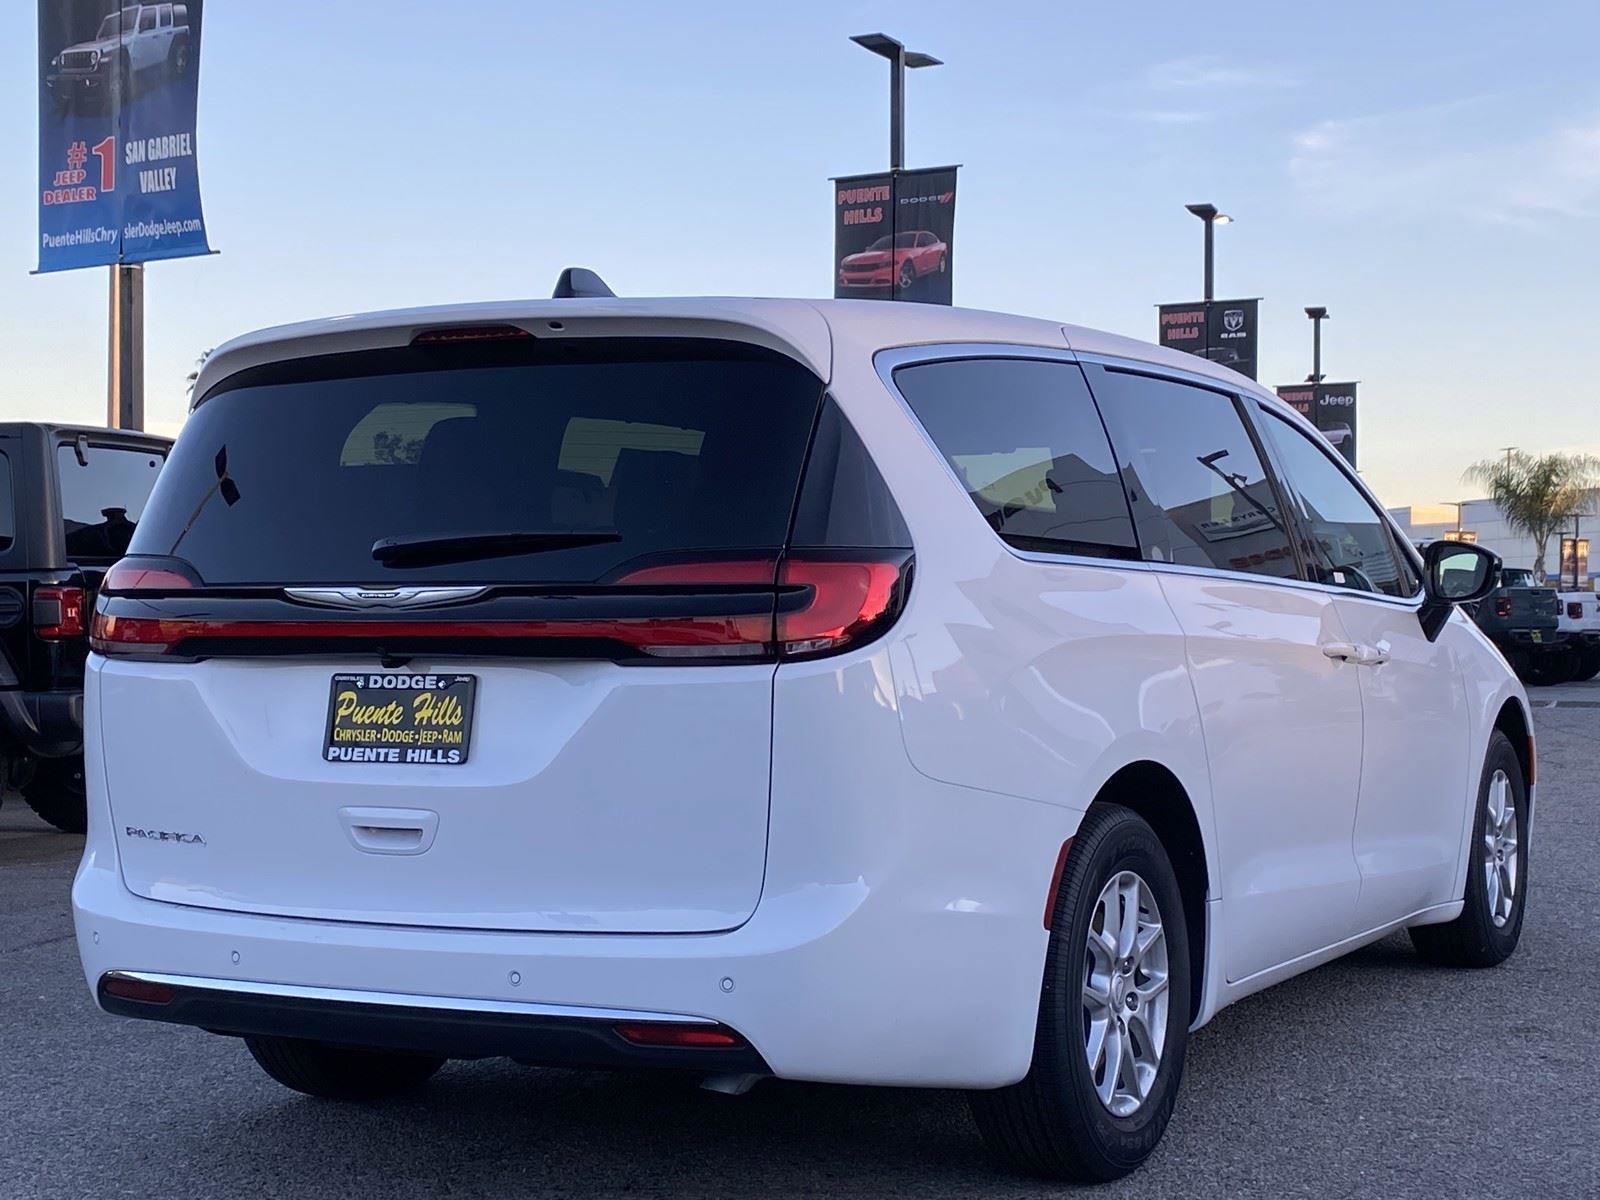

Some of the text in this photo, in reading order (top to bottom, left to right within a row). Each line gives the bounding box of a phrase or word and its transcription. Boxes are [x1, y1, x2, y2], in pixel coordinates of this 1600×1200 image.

[125, 133, 192, 165] SAN GABRIEL
[52, 169, 87, 186] JEEP
[139, 167, 177, 194] VALLEY
[43, 187, 97, 205] DEALER
[838, 186, 890, 205] PUENTE
[843, 207, 883, 225] HILLS
[1161, 311, 1204, 325] PUENTE
[1167, 326, 1198, 340] HILLS
[1319, 394, 1354, 406] Jeep
[369, 676, 437, 689] DODGE
[335, 691, 463, 726] Puente Hills
[328, 746, 460, 763] PUENTE HILLS
[126, 827, 207, 844] PACIFICA
